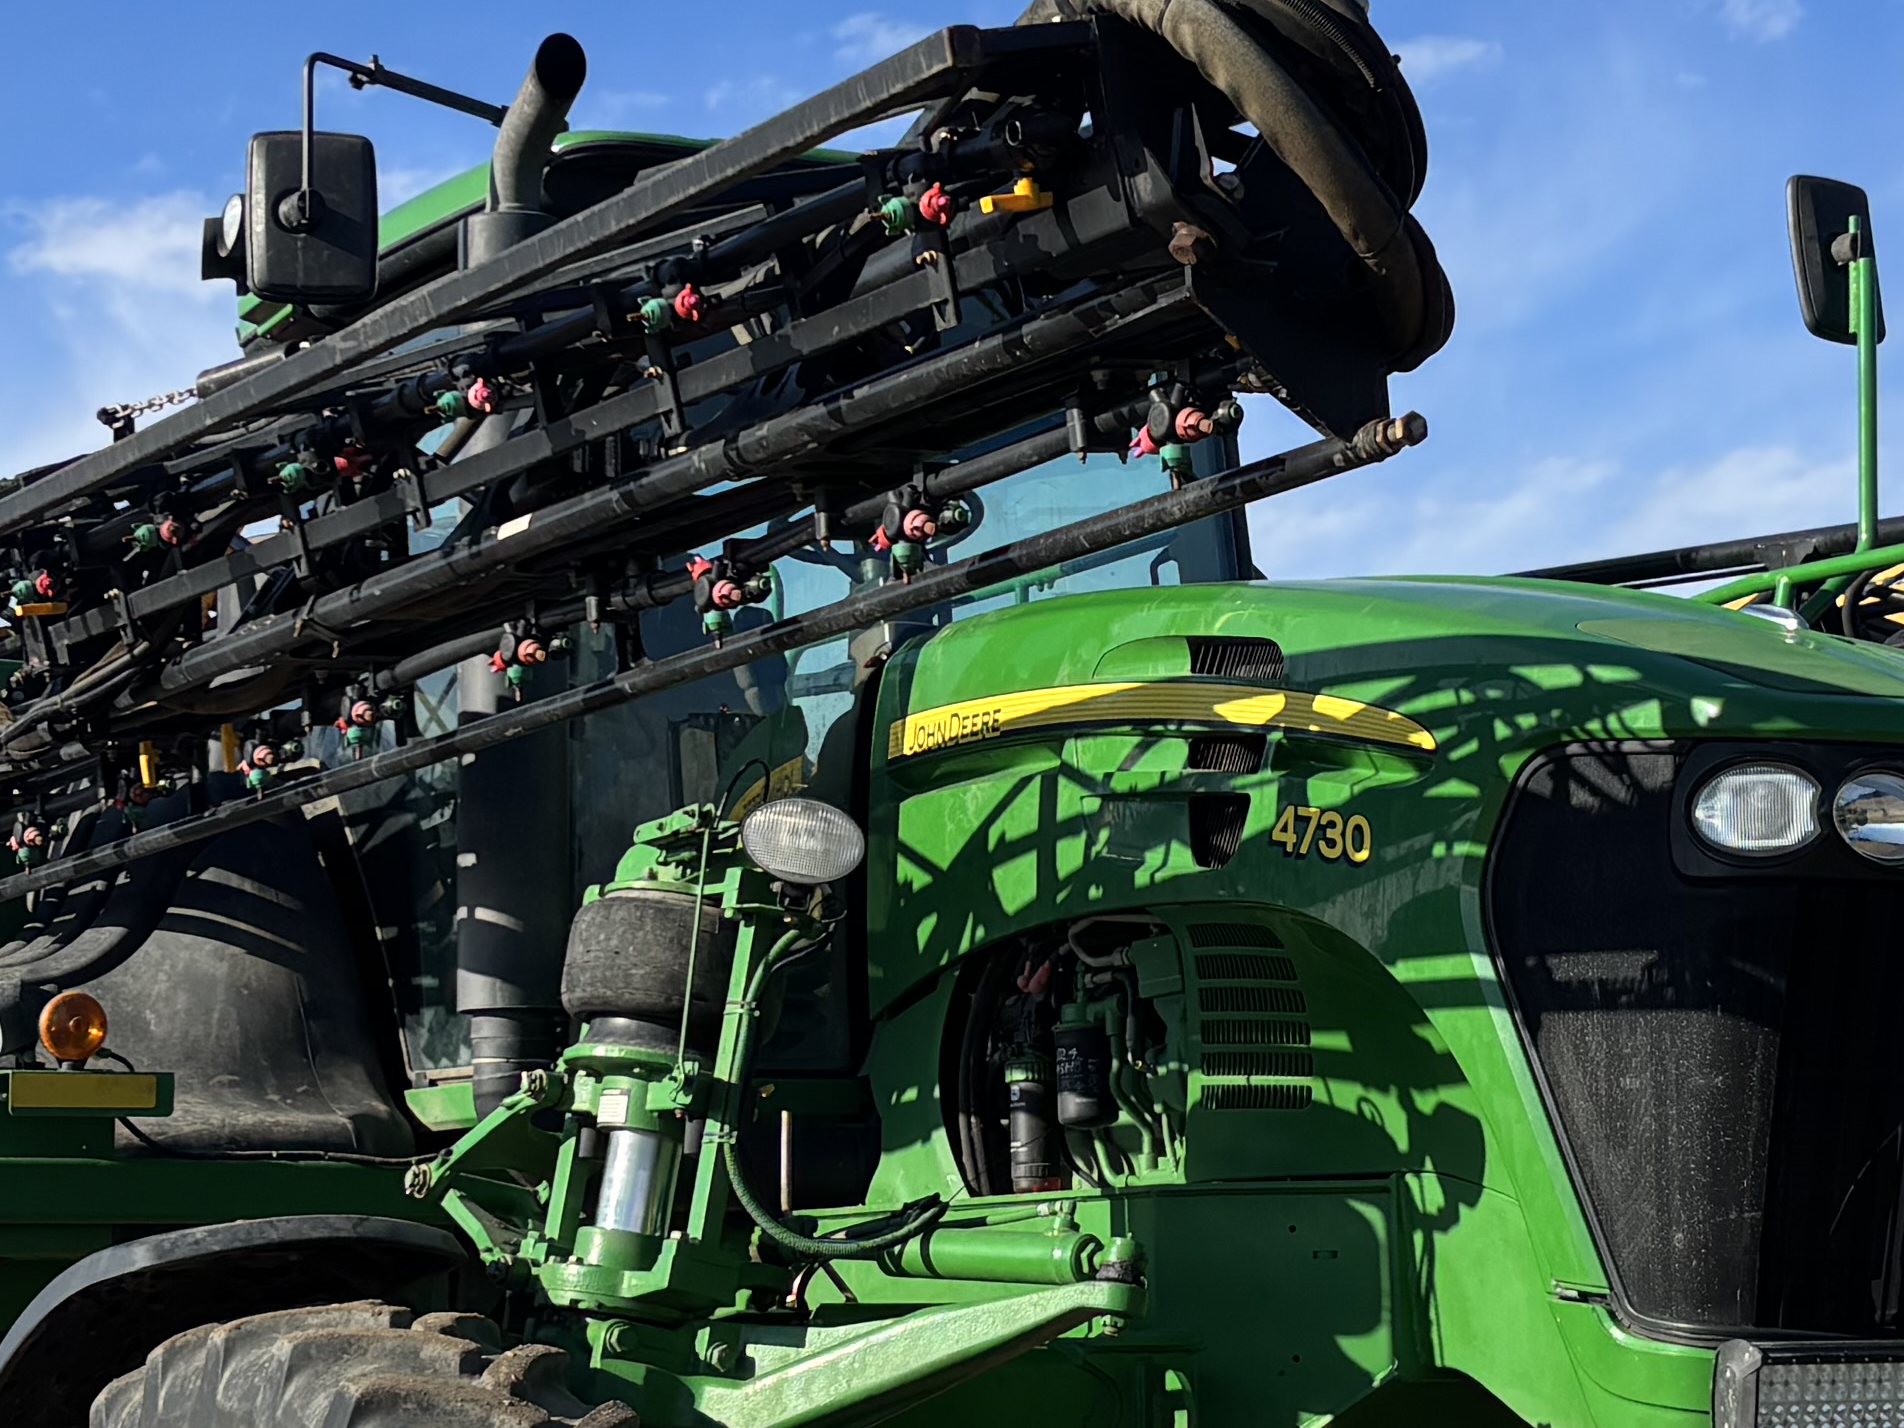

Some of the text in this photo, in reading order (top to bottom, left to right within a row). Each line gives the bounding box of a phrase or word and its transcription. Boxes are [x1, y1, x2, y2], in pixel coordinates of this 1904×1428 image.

[908, 709, 1001, 751] JOHN DEERE
[1271, 805, 1371, 863] 4730
